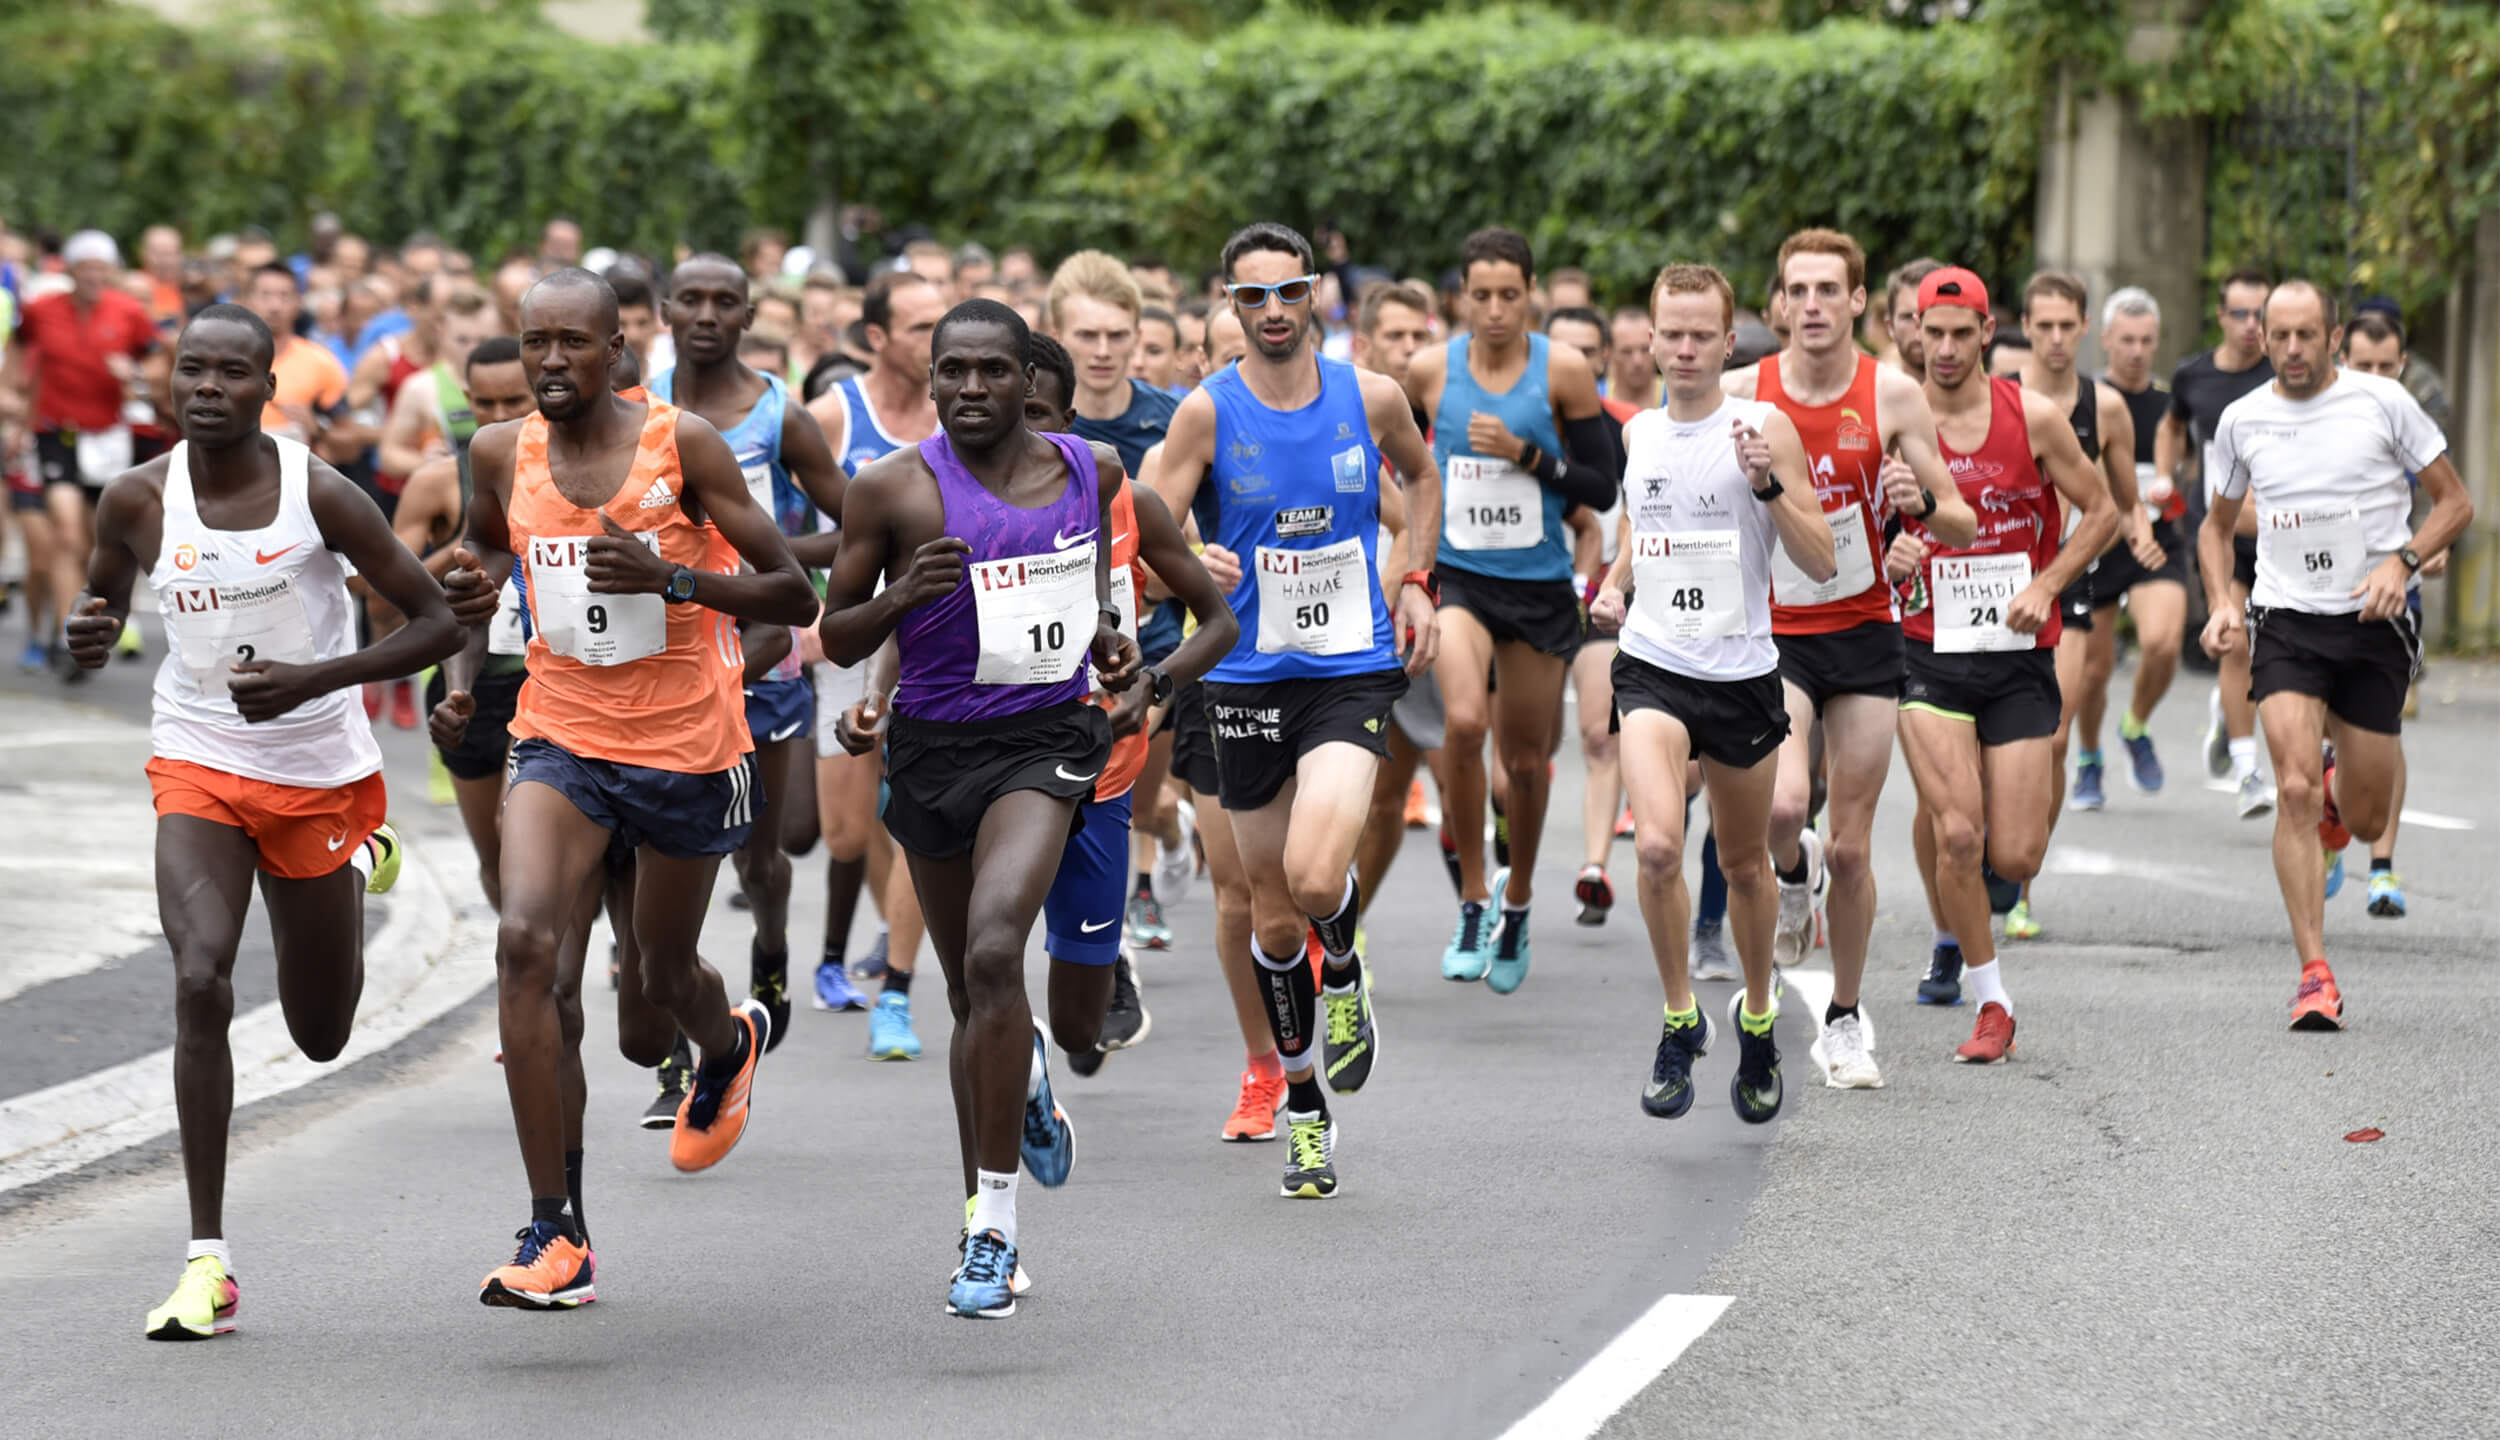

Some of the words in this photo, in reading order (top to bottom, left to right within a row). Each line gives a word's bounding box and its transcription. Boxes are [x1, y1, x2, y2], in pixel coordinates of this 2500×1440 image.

[639, 495, 676, 509] adidas
[1467, 507, 1522, 526] 1045
[1994, 517, 2032, 536] Belfort
[201, 552, 219, 561] NN
[1028, 556, 1091, 577] Montbéliard
[1302, 549, 1358, 568] Montbéliard
[2305, 551, 2333, 572] 56
[220, 580, 288, 602] Montbéliard
[1671, 588, 1704, 611] 48
[587, 605, 607, 633] 9
[1296, 602, 1330, 629] 50
[1970, 608, 1999, 626] 24
[1028, 622, 1064, 652] 10
[1215, 705, 1281, 723] OPTIQUE
[1328, 1040, 1367, 1079] BROOKS
